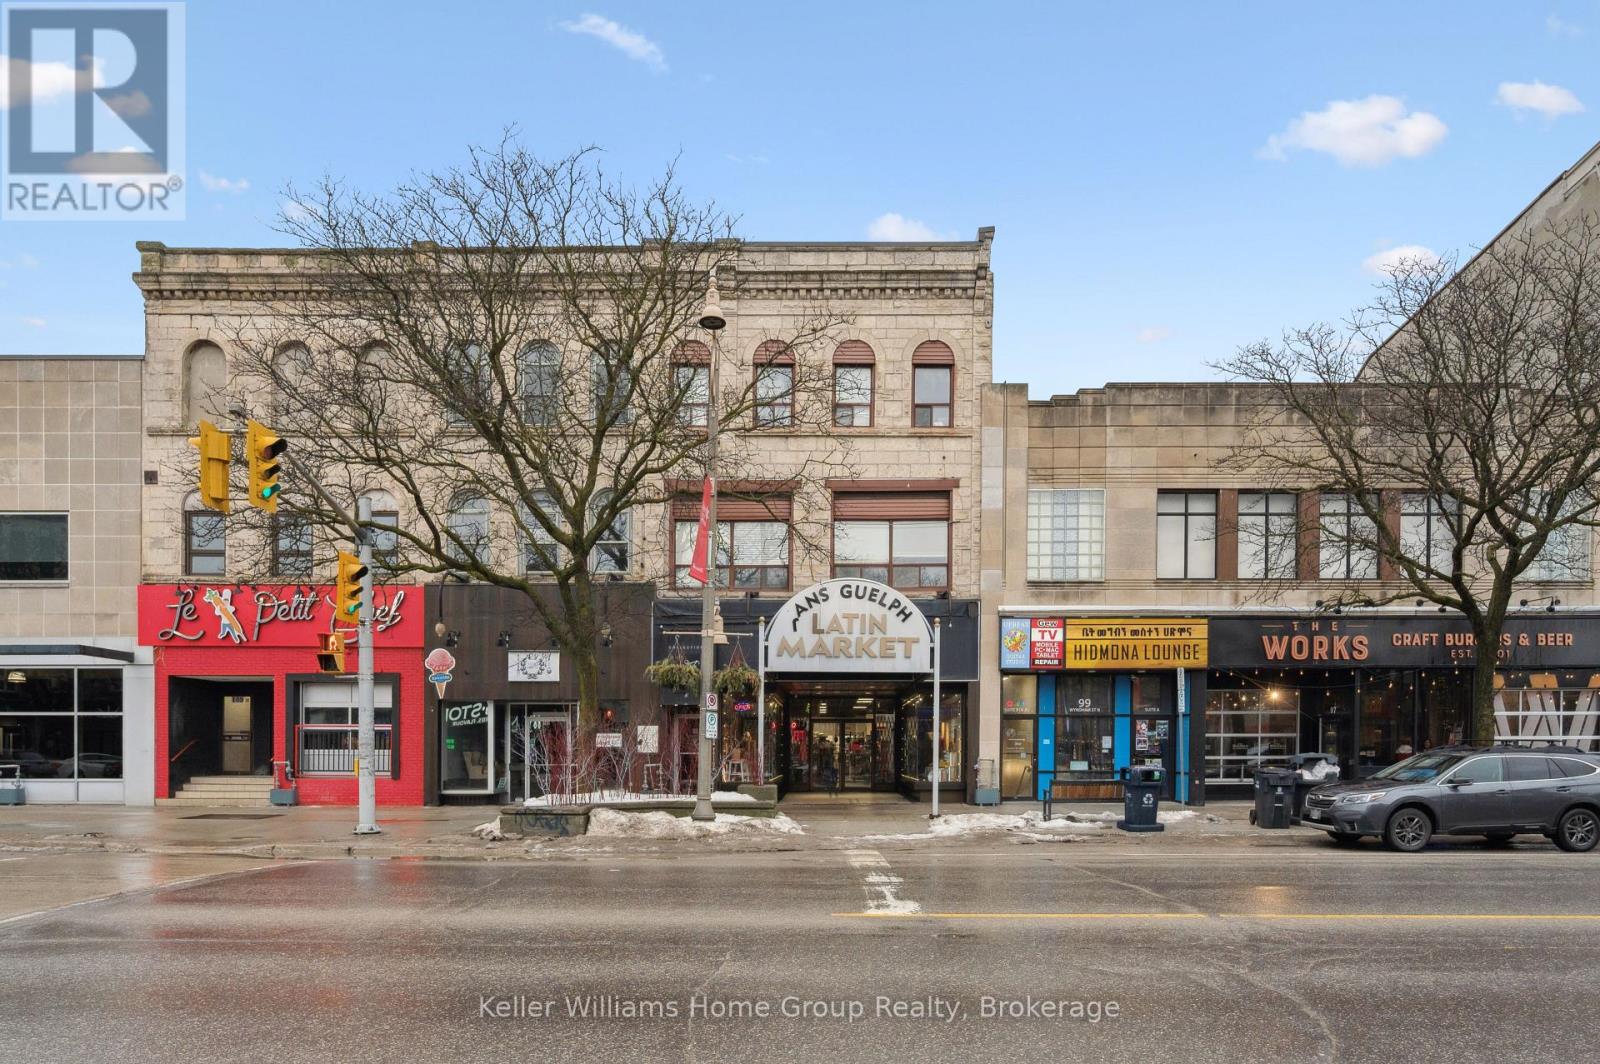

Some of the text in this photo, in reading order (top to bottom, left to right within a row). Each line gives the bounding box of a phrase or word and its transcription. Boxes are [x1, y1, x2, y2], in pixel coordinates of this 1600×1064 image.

[840, 584, 913, 624] GUELPH
[158, 588, 204, 641] Le
[252, 591, 319, 642] Petit
[812, 612, 888, 635] LATIN
[1038, 629, 1058, 641] TV
[1291, 621, 1339, 632] THE
[776, 635, 921, 660] MARKET
[1261, 634, 1370, 661] WORKS
[1392, 633, 1439, 646] CRAFT
[1519, 633, 1530, 646] &
[1537, 633, 1574, 646] BEER
[1073, 644, 1200, 661] HIDMONA LOUNGE
[1450, 649, 1473, 659] EST.
[1078, 698, 1092, 708] 99
